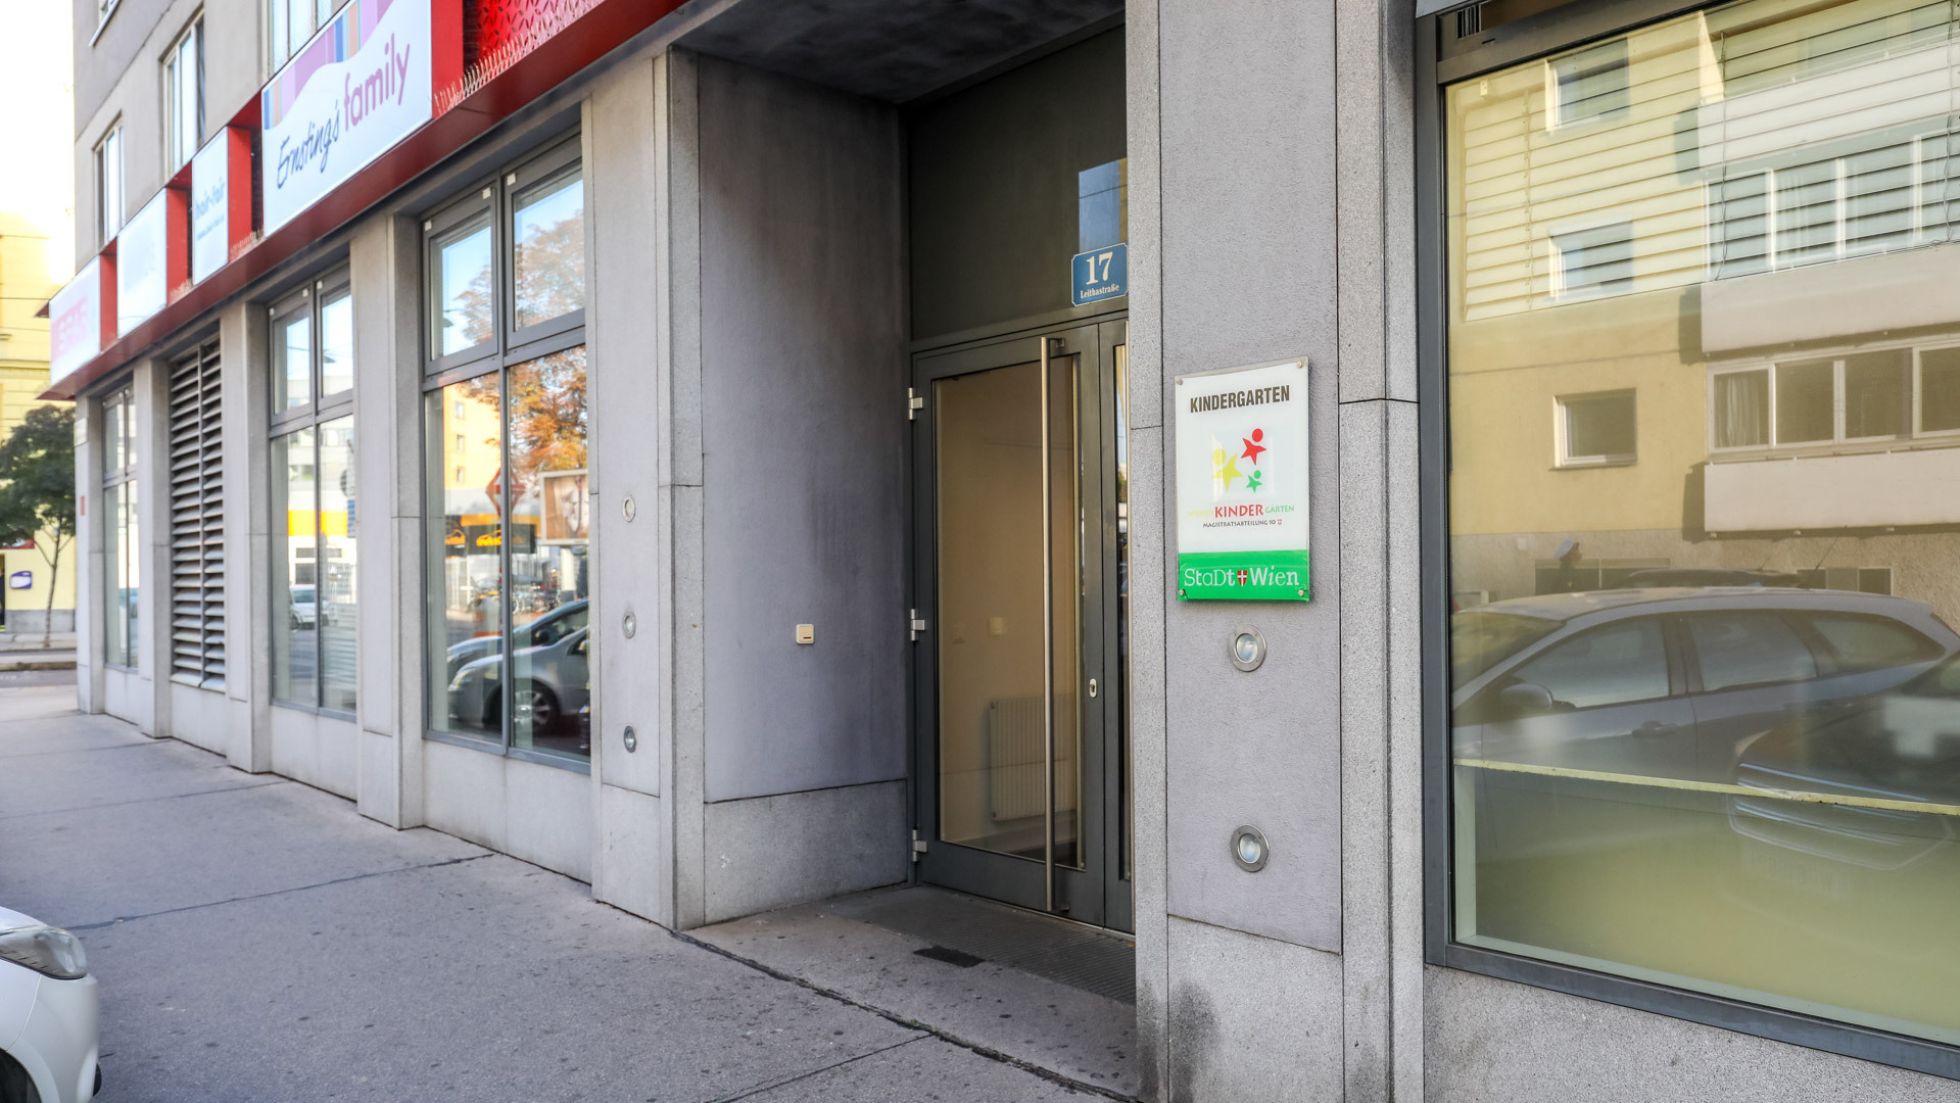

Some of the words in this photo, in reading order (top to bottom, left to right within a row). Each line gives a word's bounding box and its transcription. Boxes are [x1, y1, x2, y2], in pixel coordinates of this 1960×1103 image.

[276, 98, 341, 190] Ernsting's
[343, 31, 411, 132] family
[1085, 251, 1114, 286] 17
[1189, 384, 1291, 414] KINDERGARTEN
[1249, 566, 1301, 587] Wien
